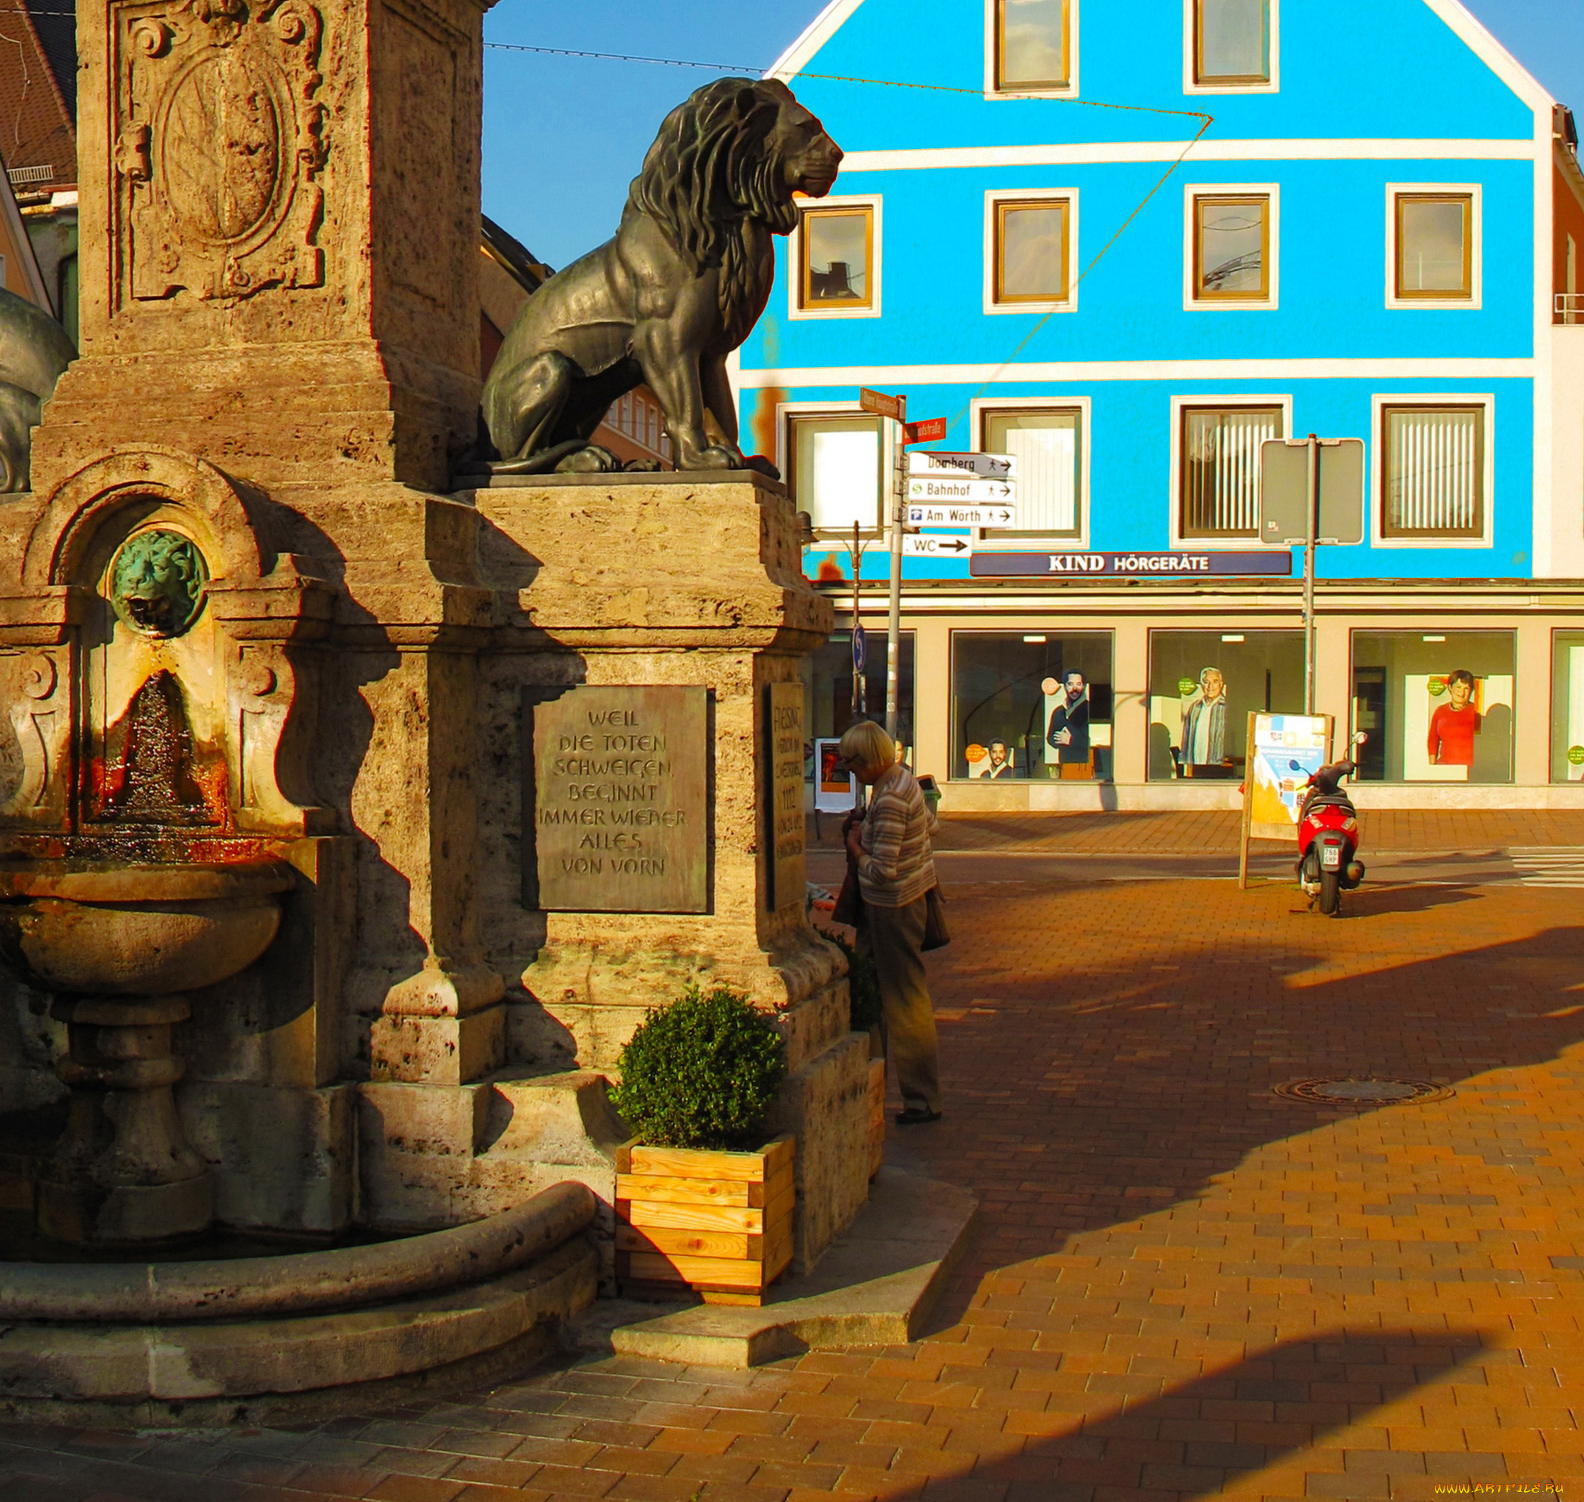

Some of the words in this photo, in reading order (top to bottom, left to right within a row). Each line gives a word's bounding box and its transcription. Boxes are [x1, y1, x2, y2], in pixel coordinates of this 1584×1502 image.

[928, 456, 975, 473] Domberg
[927, 483, 971, 495] Bahnhof
[927, 510, 943, 521] Am
[949, 509, 981, 522] Wörth
[914, 539, 937, 552] WC
[1048, 554, 1105, 572] KIND
[1113, 554, 1210, 571] HÖRGERÄTE
[588, 710, 639, 727] WEIL
[559, 735, 594, 752] DIE
[603, 734, 667, 752] TOTEN
[568, 785, 658, 802] BEGINNT
[539, 808, 606, 826] IMMER
[609, 809, 689, 827] WIEDER
[579, 833, 643, 850] ALLES
[561, 858, 602, 875] VON
[611, 858, 665, 876] VORN
